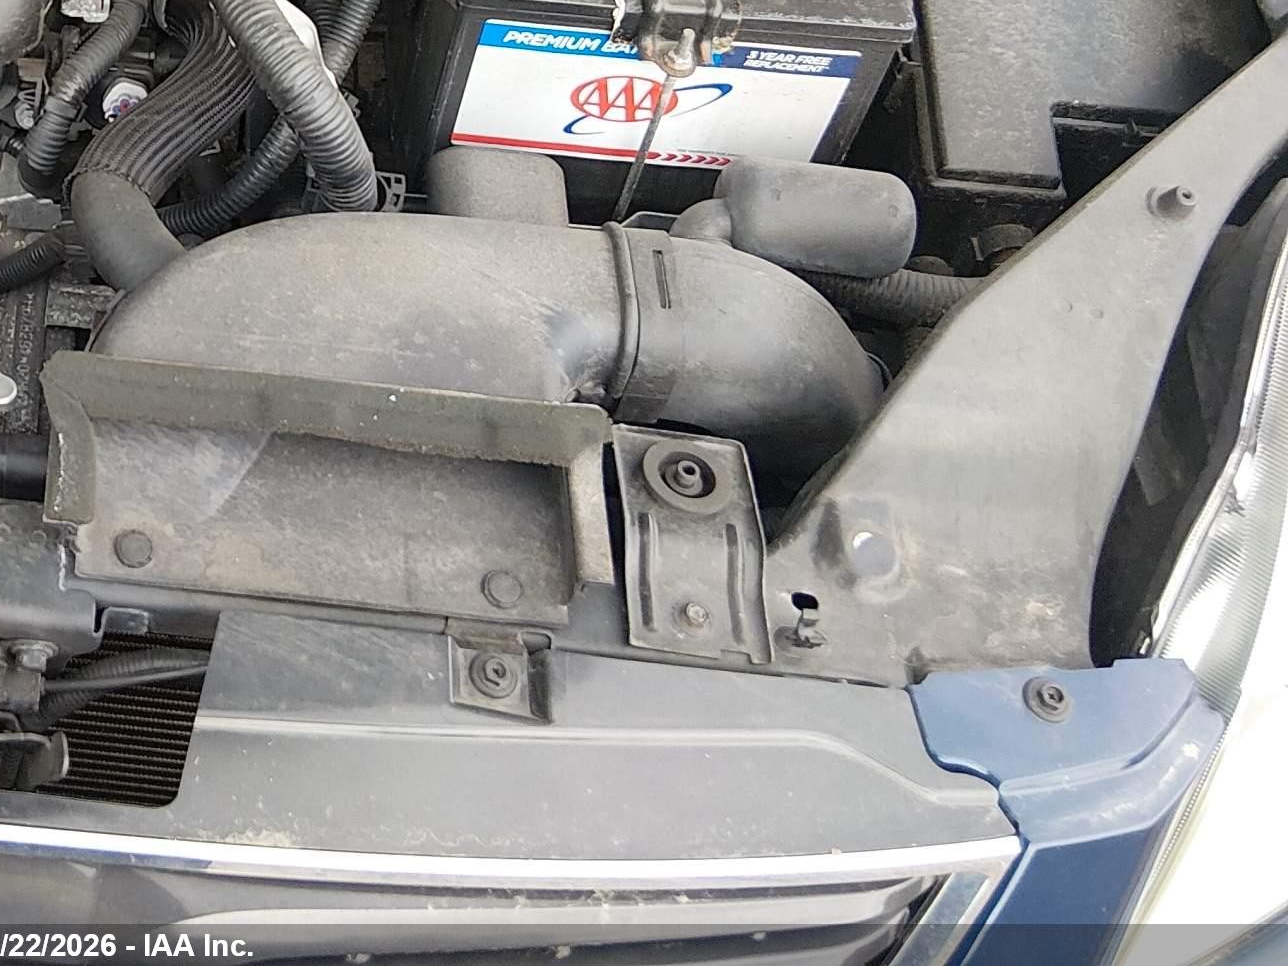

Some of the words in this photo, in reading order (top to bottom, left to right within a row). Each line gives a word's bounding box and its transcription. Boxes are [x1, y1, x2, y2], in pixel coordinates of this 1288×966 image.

[503, 30, 602, 52] PREMIUM
[759, 51, 796, 63] YEAR
[795, 54, 833, 66] FREE
[578, 76, 672, 123] AAA
